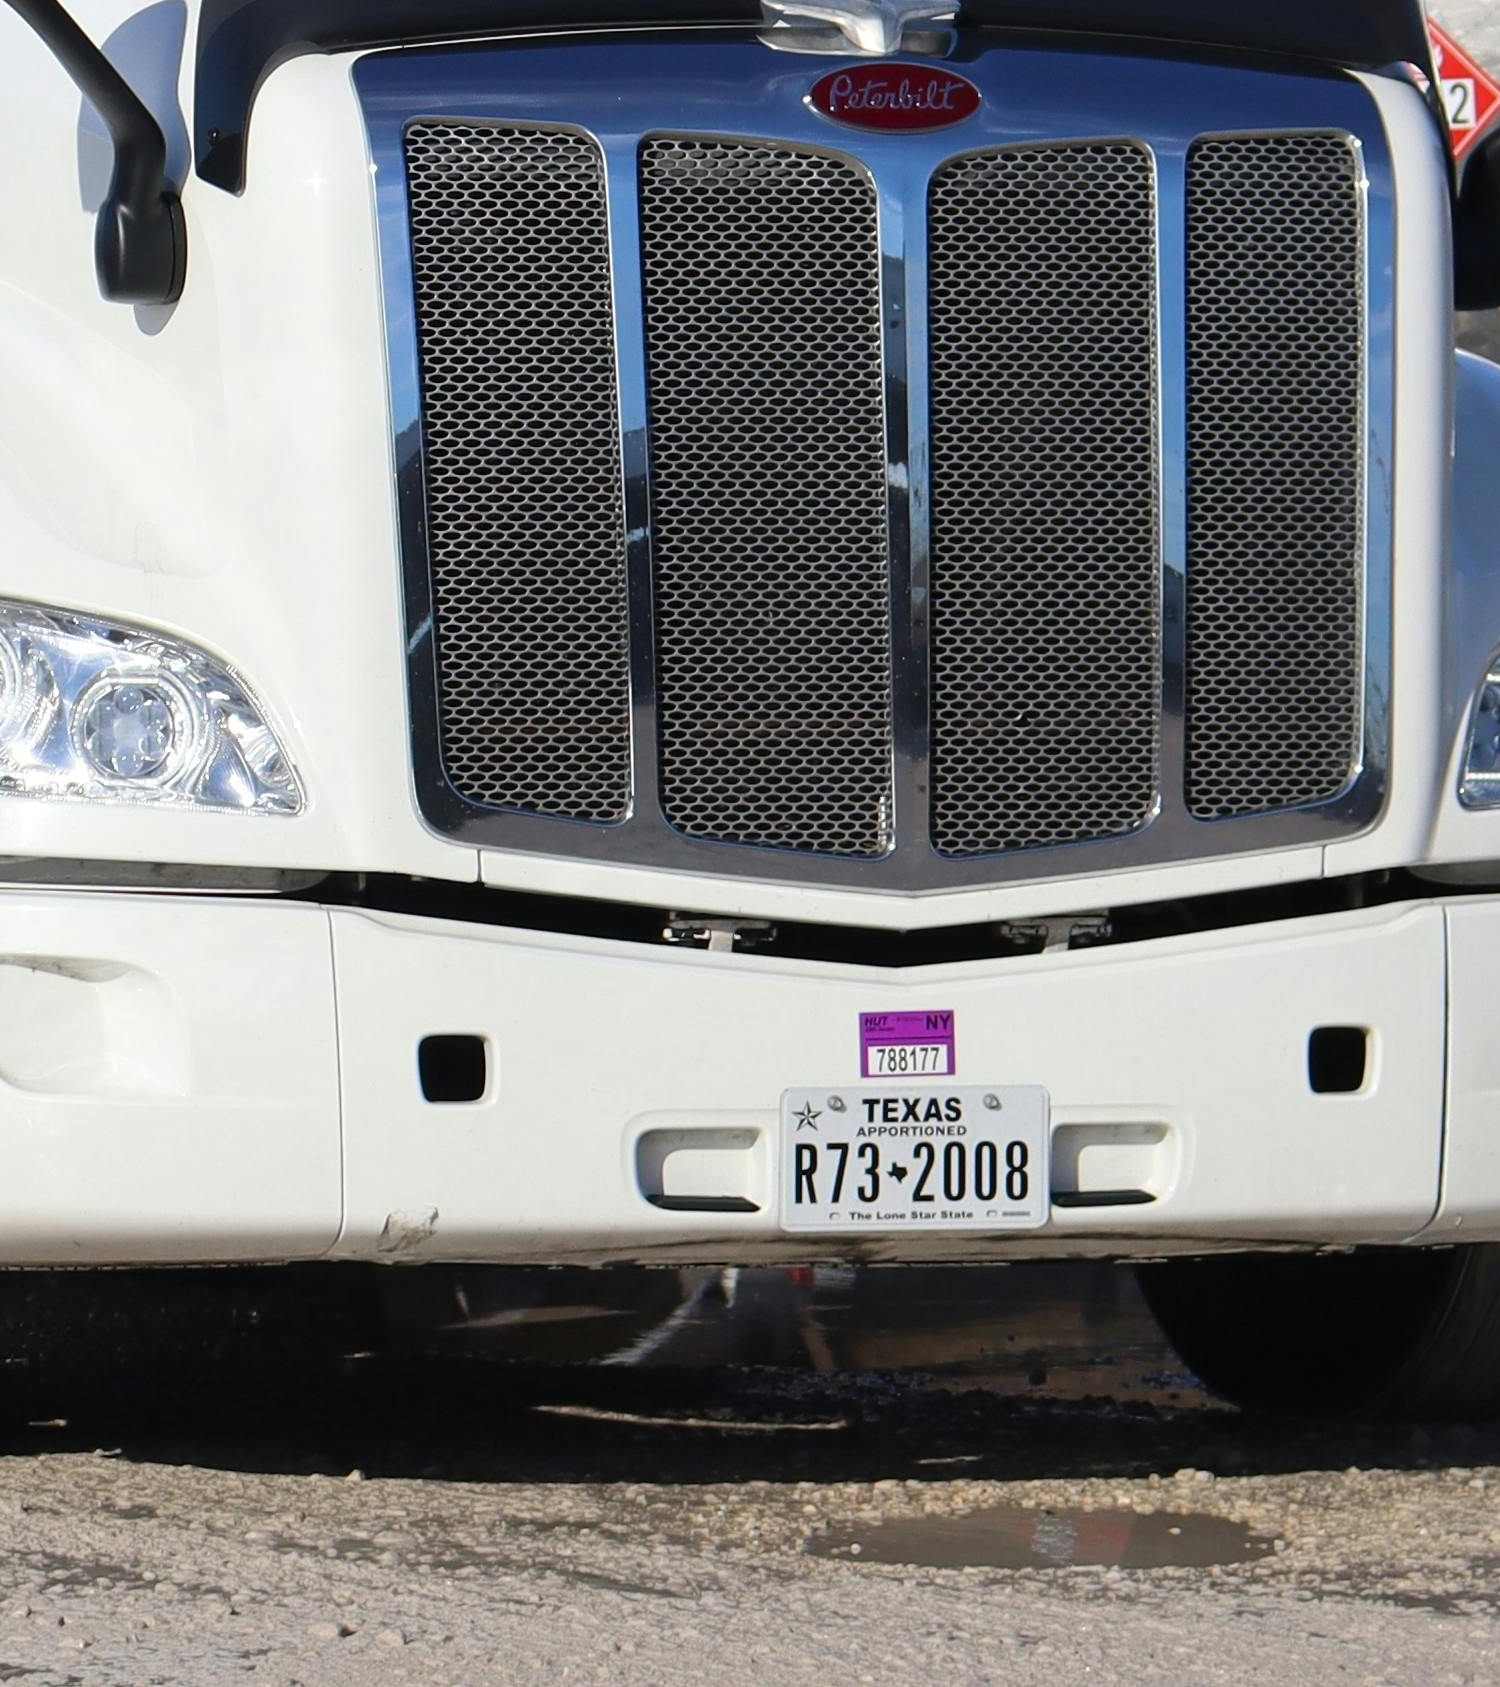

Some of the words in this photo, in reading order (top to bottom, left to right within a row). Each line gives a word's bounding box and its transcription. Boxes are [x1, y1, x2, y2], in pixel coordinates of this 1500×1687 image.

[829, 74, 965, 110] Peterbilt
[864, 1015, 889, 1026] HUT
[925, 1014, 951, 1030] NY
[876, 1047, 940, 1072] 788177
[862, 1097, 963, 1124] TEXAS
[856, 1124, 967, 1138] APPORTIONED
[849, 1211, 872, 1221] The
[876, 1211, 906, 1221] Lone
[911, 1210, 936, 1220] Star
[940, 1210, 974, 1220] State
